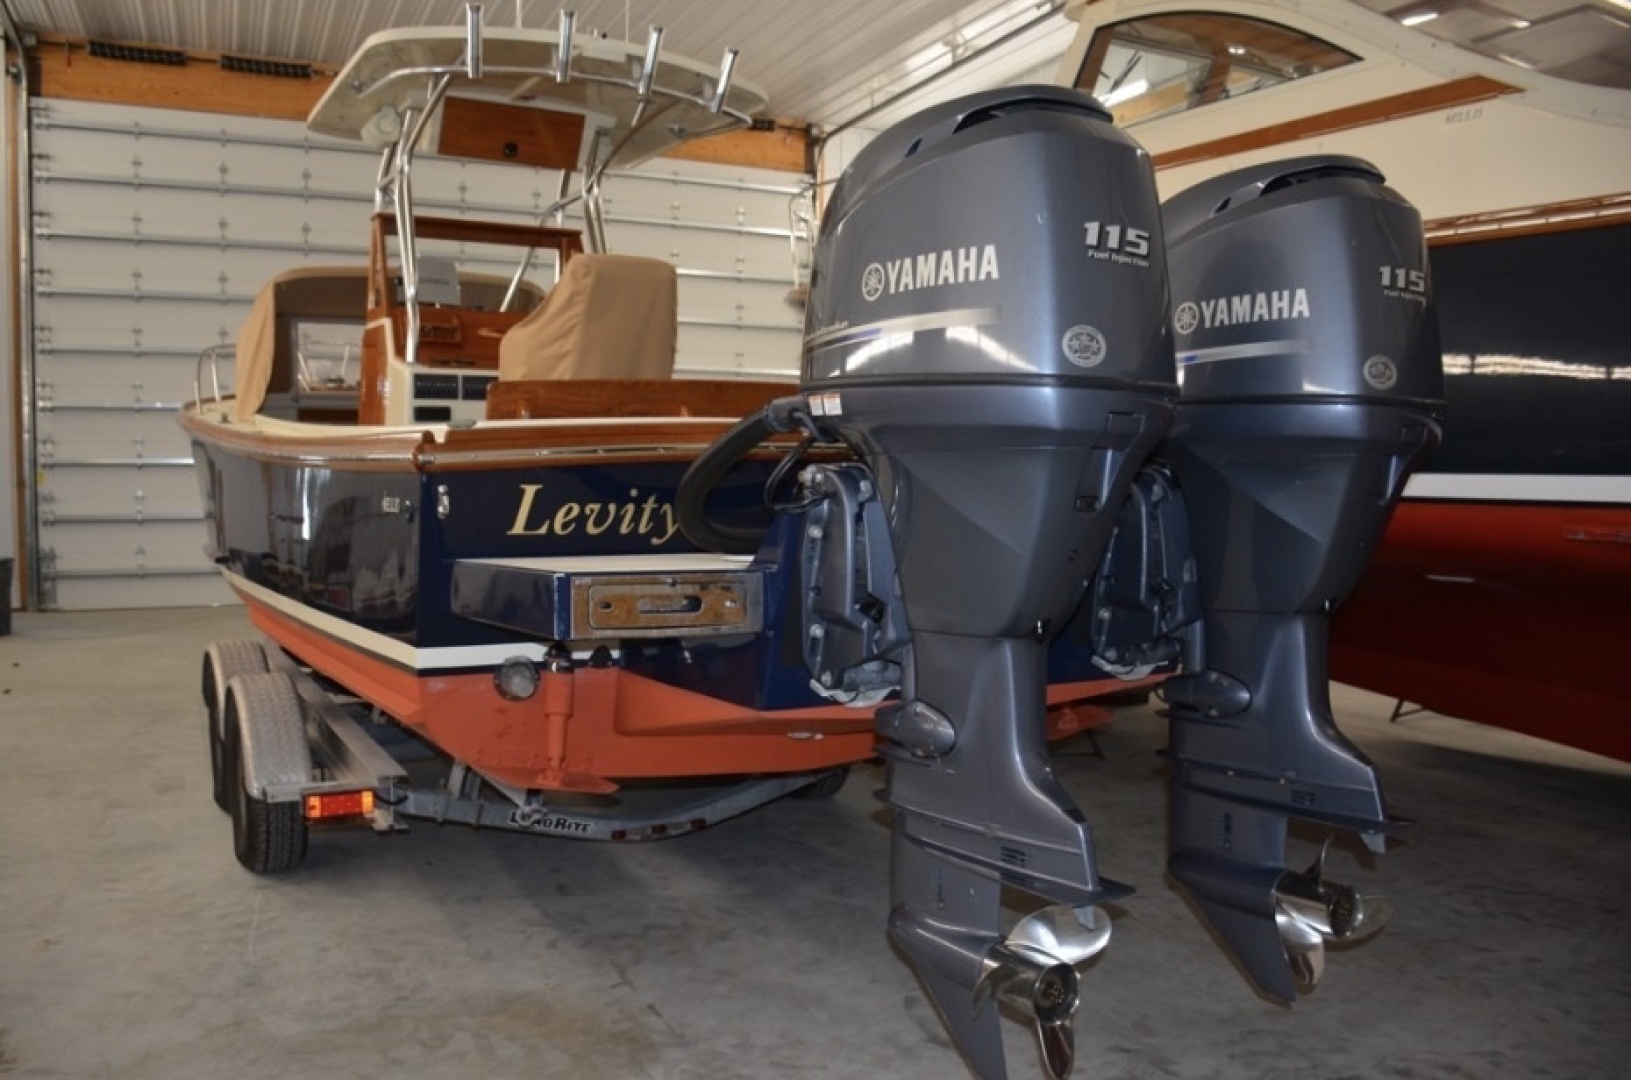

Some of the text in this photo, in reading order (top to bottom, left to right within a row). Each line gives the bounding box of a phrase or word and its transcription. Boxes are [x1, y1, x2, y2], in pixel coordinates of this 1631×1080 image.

[1084, 222, 1149, 255] 115
[887, 245, 998, 294] YAMAHA
[1380, 266, 1424, 292] 115
[1201, 289, 1310, 328] YAMAHA
[506, 484, 679, 545] Levity
